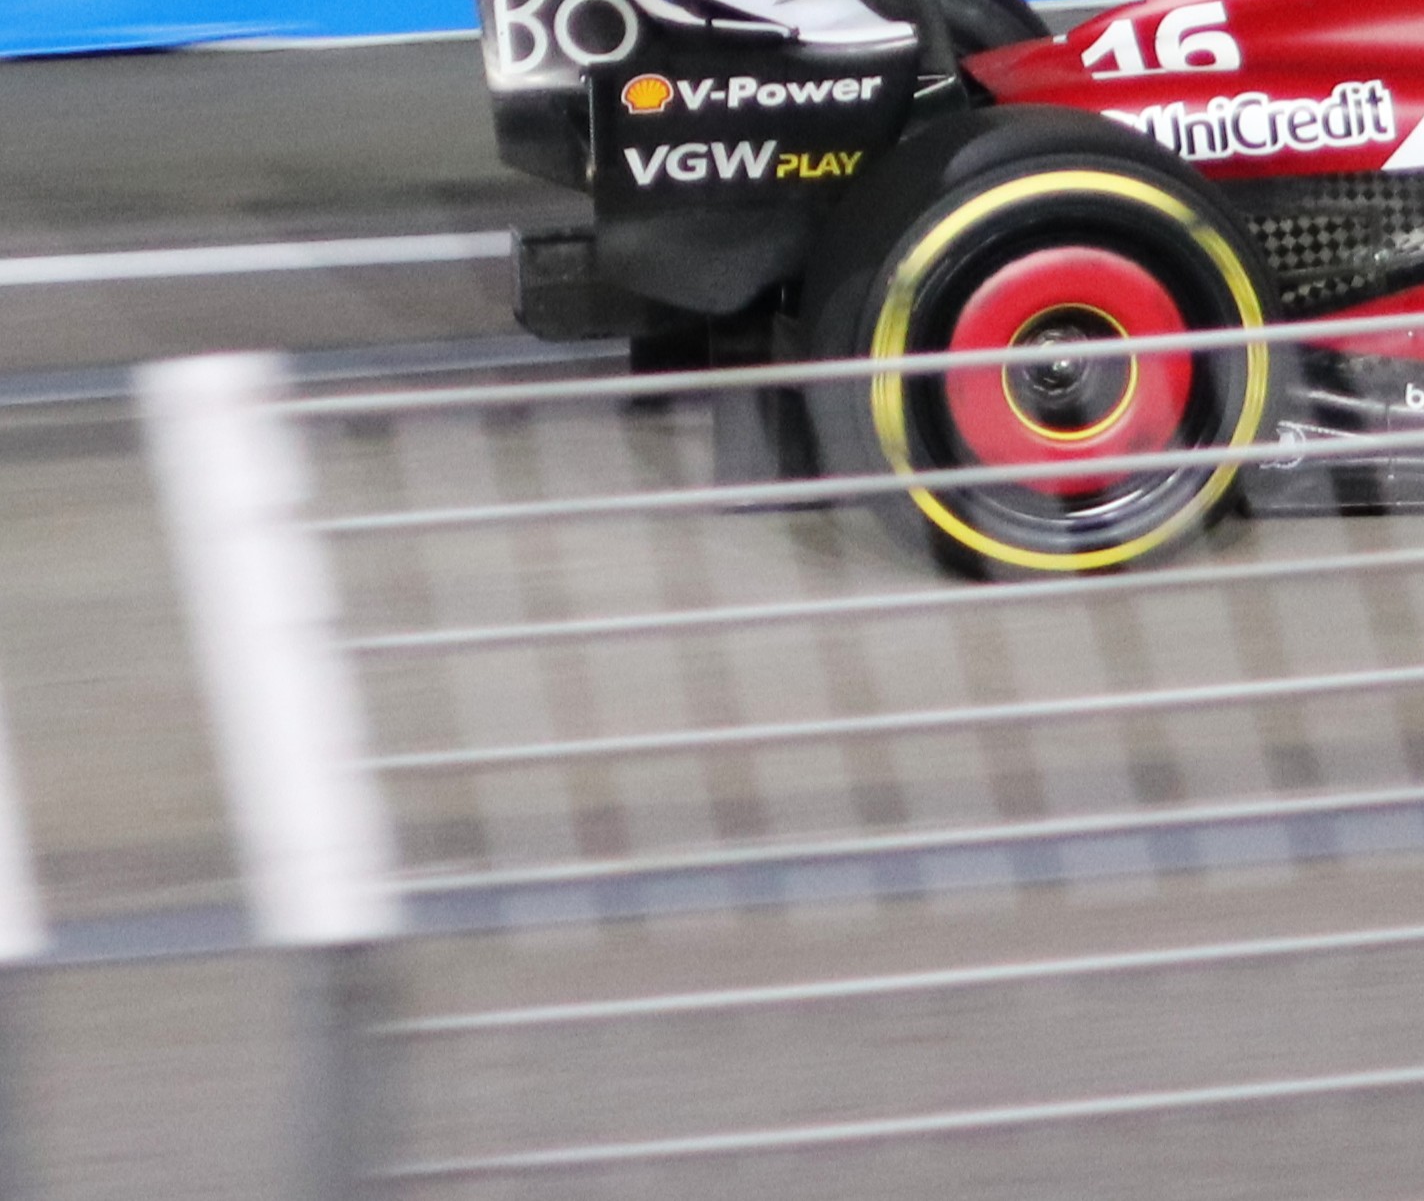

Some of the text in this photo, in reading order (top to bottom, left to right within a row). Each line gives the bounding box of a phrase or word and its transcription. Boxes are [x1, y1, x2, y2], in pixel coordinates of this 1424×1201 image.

[1082, 1, 1241, 80] 16
[677, 74, 884, 111] V-Power
[1145, 81, 1391, 157] UniCredit
[623, 139, 864, 187] VGW PLAY
